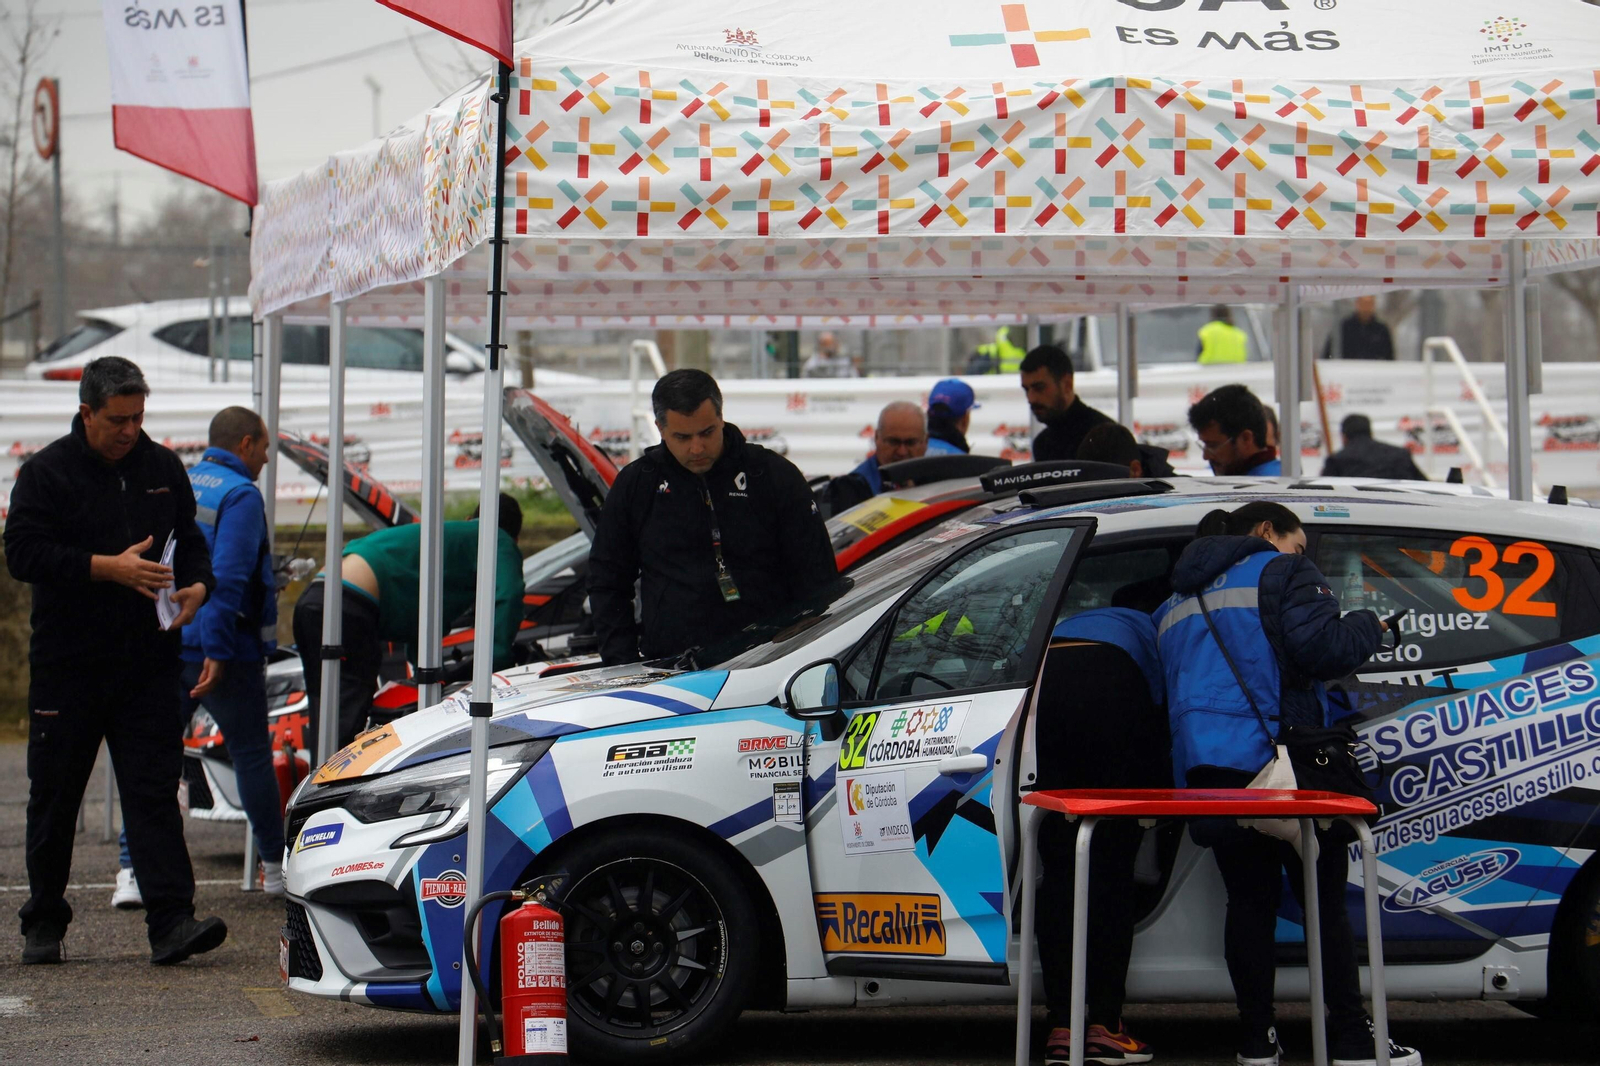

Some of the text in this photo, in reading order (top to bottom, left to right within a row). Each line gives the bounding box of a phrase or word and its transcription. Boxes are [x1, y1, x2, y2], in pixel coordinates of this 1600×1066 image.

[1115, 26, 1179, 46] ES
[676, 43, 749, 58] AYUNTAMIENTO
[765, 53, 813, 62] CÓRDOBA
[188, 473, 223, 488] SARIO
[1449, 535, 1557, 617] 32
[1355, 663, 1594, 774] ESGUACES
[839, 713, 877, 769] 32
[869, 739, 920, 762] CÓRDOBA
[921, 745, 955, 757] HUMANIDAD
[653, 757, 692, 765] andaluza
[603, 764, 693, 777] de automovilismo
[750, 771, 791, 779] FINANCIAL
[866, 782, 895, 797] Diputación
[867, 796, 898, 809] de Córdoba
[305, 831, 336, 844] MICHELIN
[331, 861, 385, 877] COLOMBES.es
[1422, 856, 1468, 877] COMERCIAL
[1411, 857, 1499, 904] AGUSE
[533, 920, 560, 930] Bellido
[842, 902, 921, 945] Recalvi
[517, 942, 525, 989] POLVO
